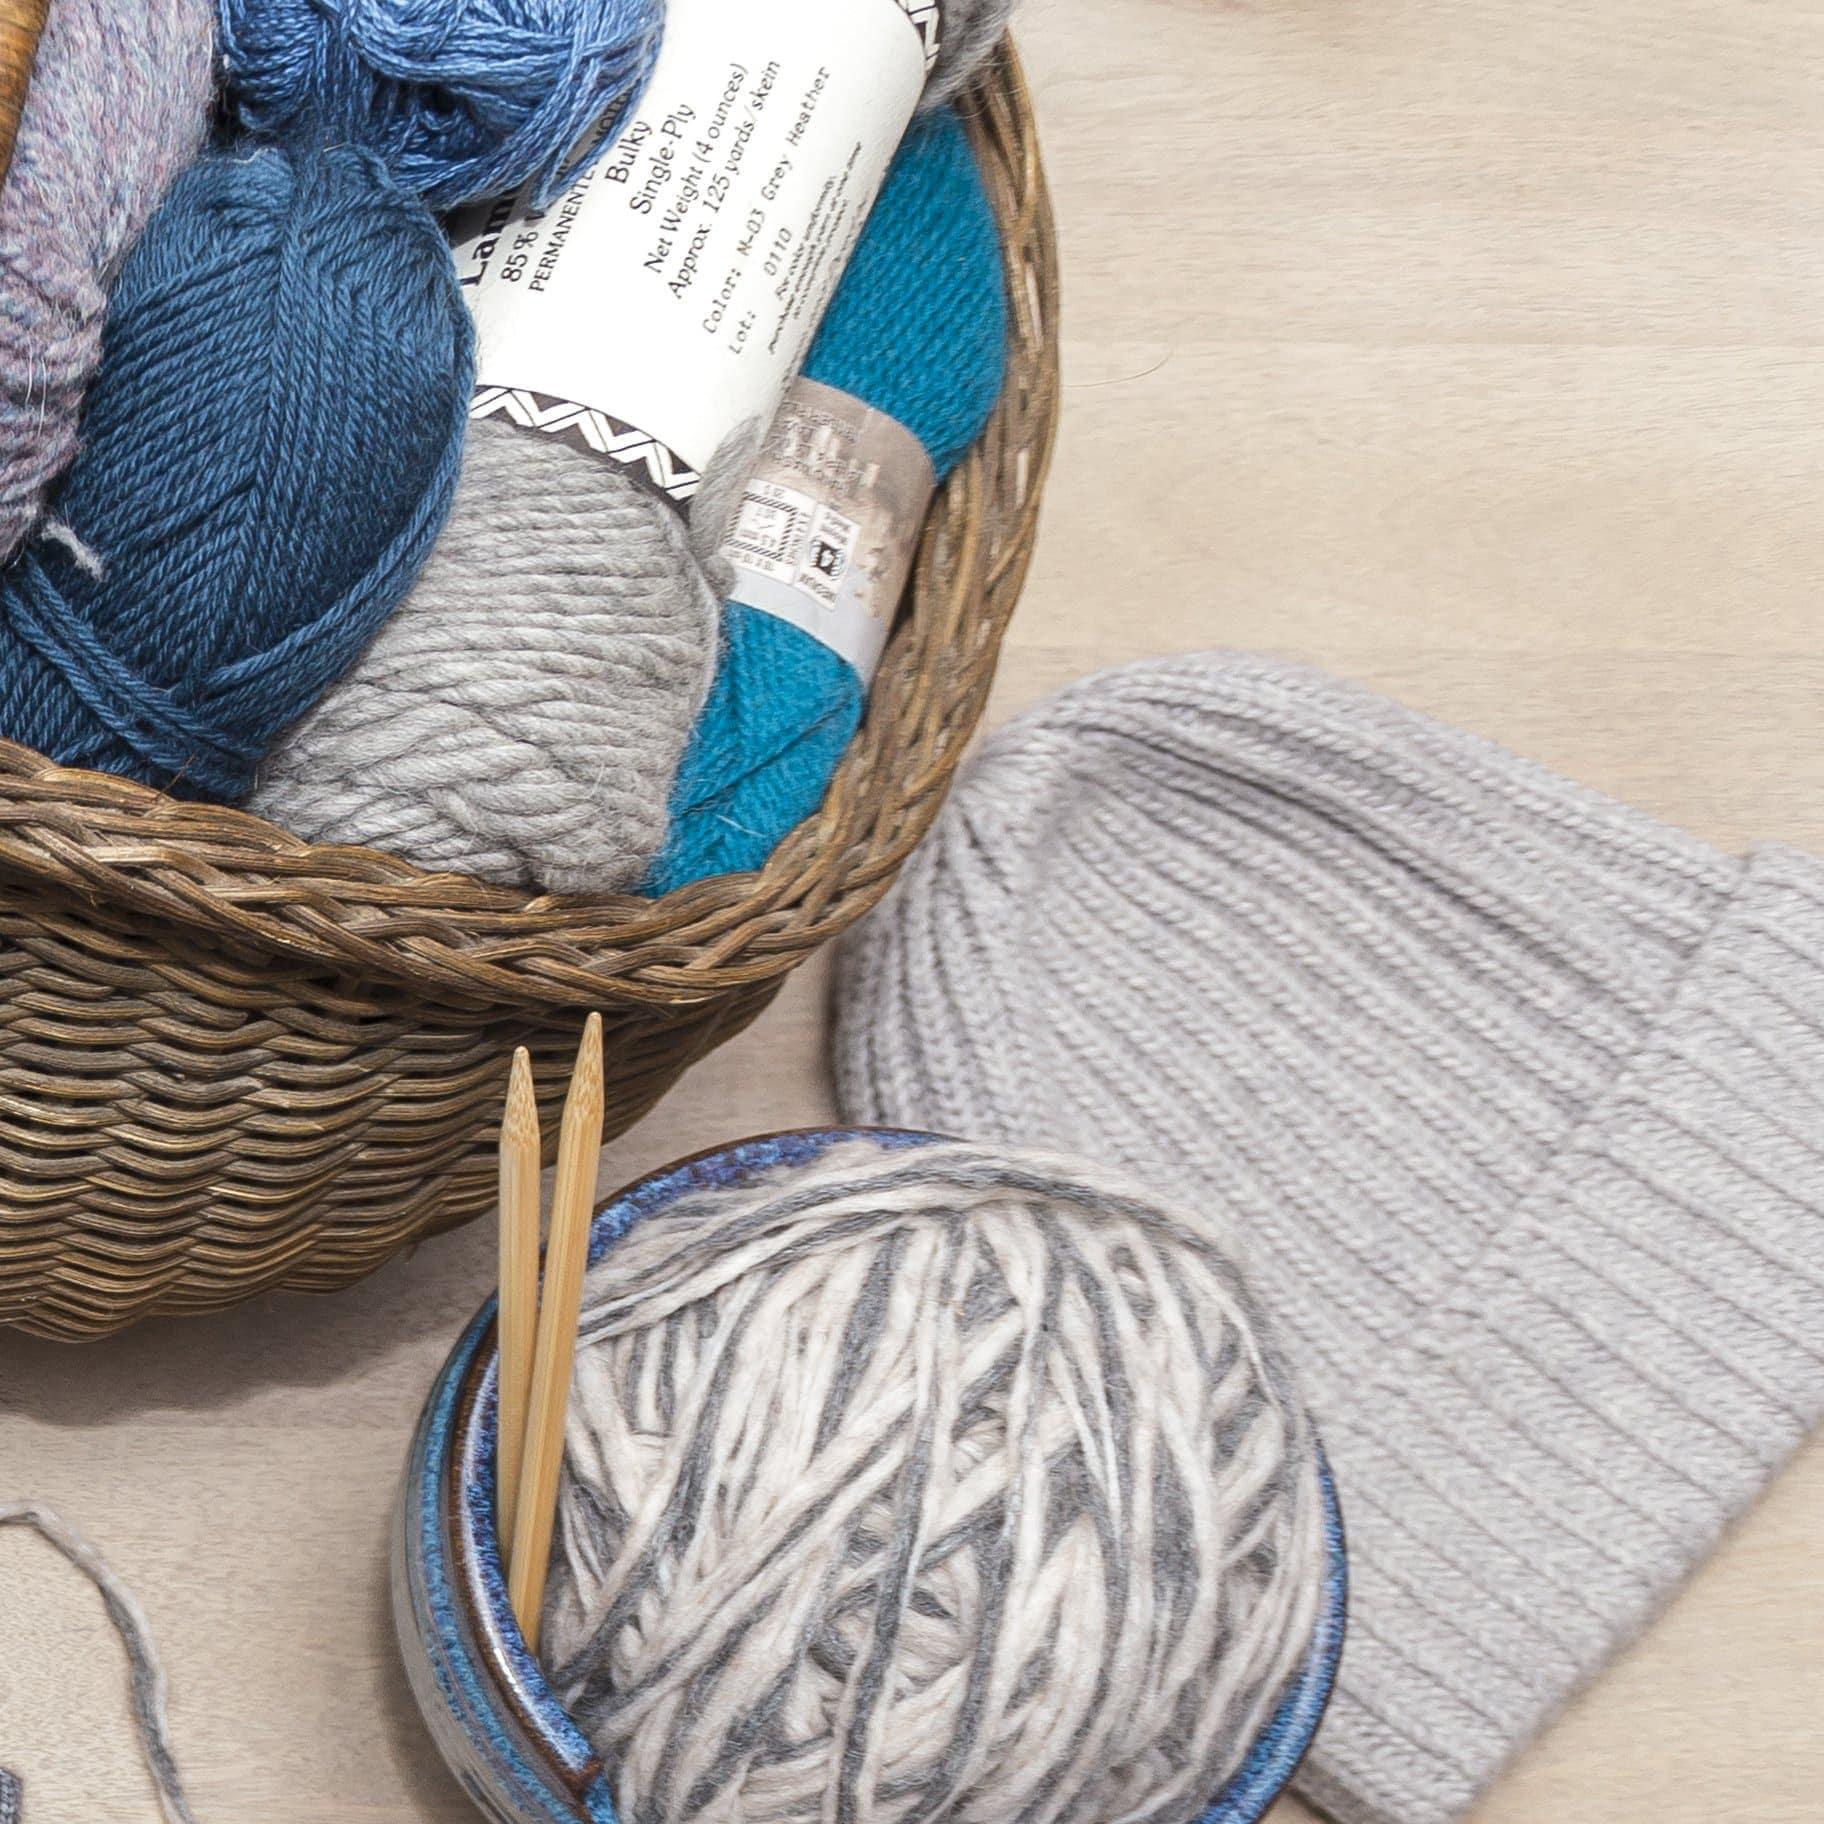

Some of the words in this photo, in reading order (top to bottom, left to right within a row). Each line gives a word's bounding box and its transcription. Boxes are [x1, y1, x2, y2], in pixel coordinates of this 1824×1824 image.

[606, 120, 653, 184] Bulky
[630, 104, 696, 214] Single-Ply
[644, 237, 671, 273] Net
[660, 166, 703, 232] Weight
[693, 140, 714, 164] (4
[707, 62, 749, 139] ounces)
[703, 173, 731, 213] 125
[703, 268, 742, 334] Color:
[760, 153, 793, 201] Grey
[786, 65, 830, 146] Heather
[459, 193, 517, 286] Lam
[529, 163, 599, 291] PERMANENTL
